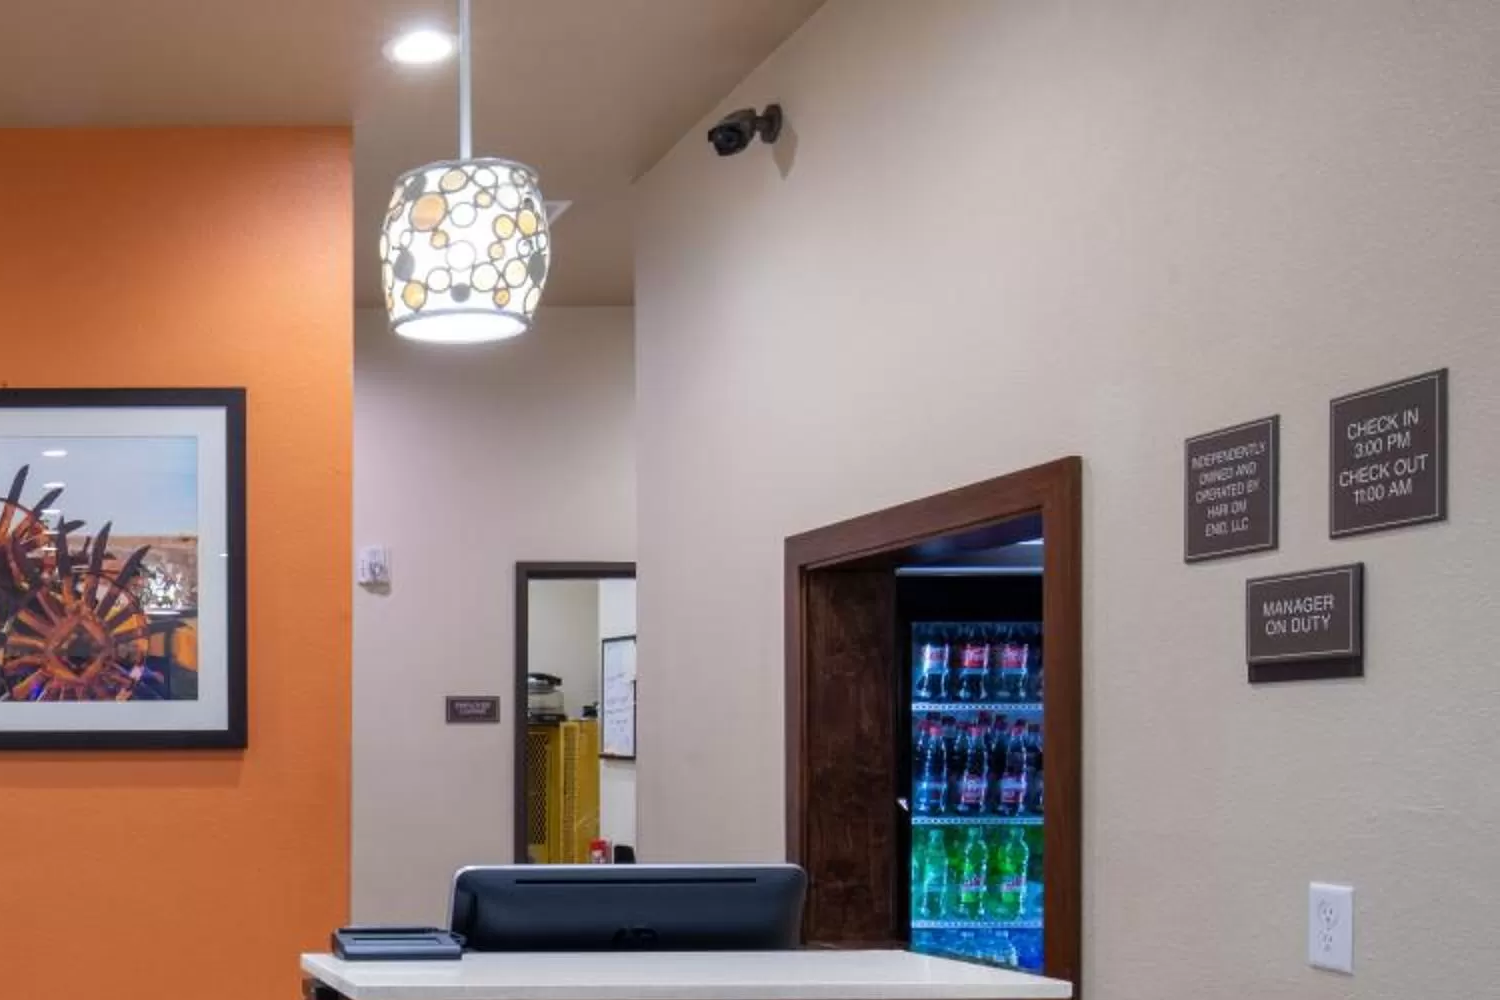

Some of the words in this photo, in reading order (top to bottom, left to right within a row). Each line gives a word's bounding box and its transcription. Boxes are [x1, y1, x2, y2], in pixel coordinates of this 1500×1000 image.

[1347, 413, 1398, 440] CHECK
[1403, 407, 1419, 427] IN
[1355, 438, 1382, 459] 3:00
[1387, 431, 1411, 452] PM
[1199, 467, 1233, 485] OWNED
[1236, 461, 1257, 476] AND
[1340, 461, 1390, 487] CHECK
[1394, 453, 1428, 476] OUT
[1196, 481, 1244, 504] OPERATED
[1246, 479, 1260, 493] BY
[1353, 484, 1385, 505] 11:00
[1388, 477, 1412, 497] AM
[1232, 516, 1249, 532] LLC
[1263, 593, 1335, 616] MANAGER
[1265, 619, 1287, 635] ON
[1291, 613, 1331, 633] DUTY
